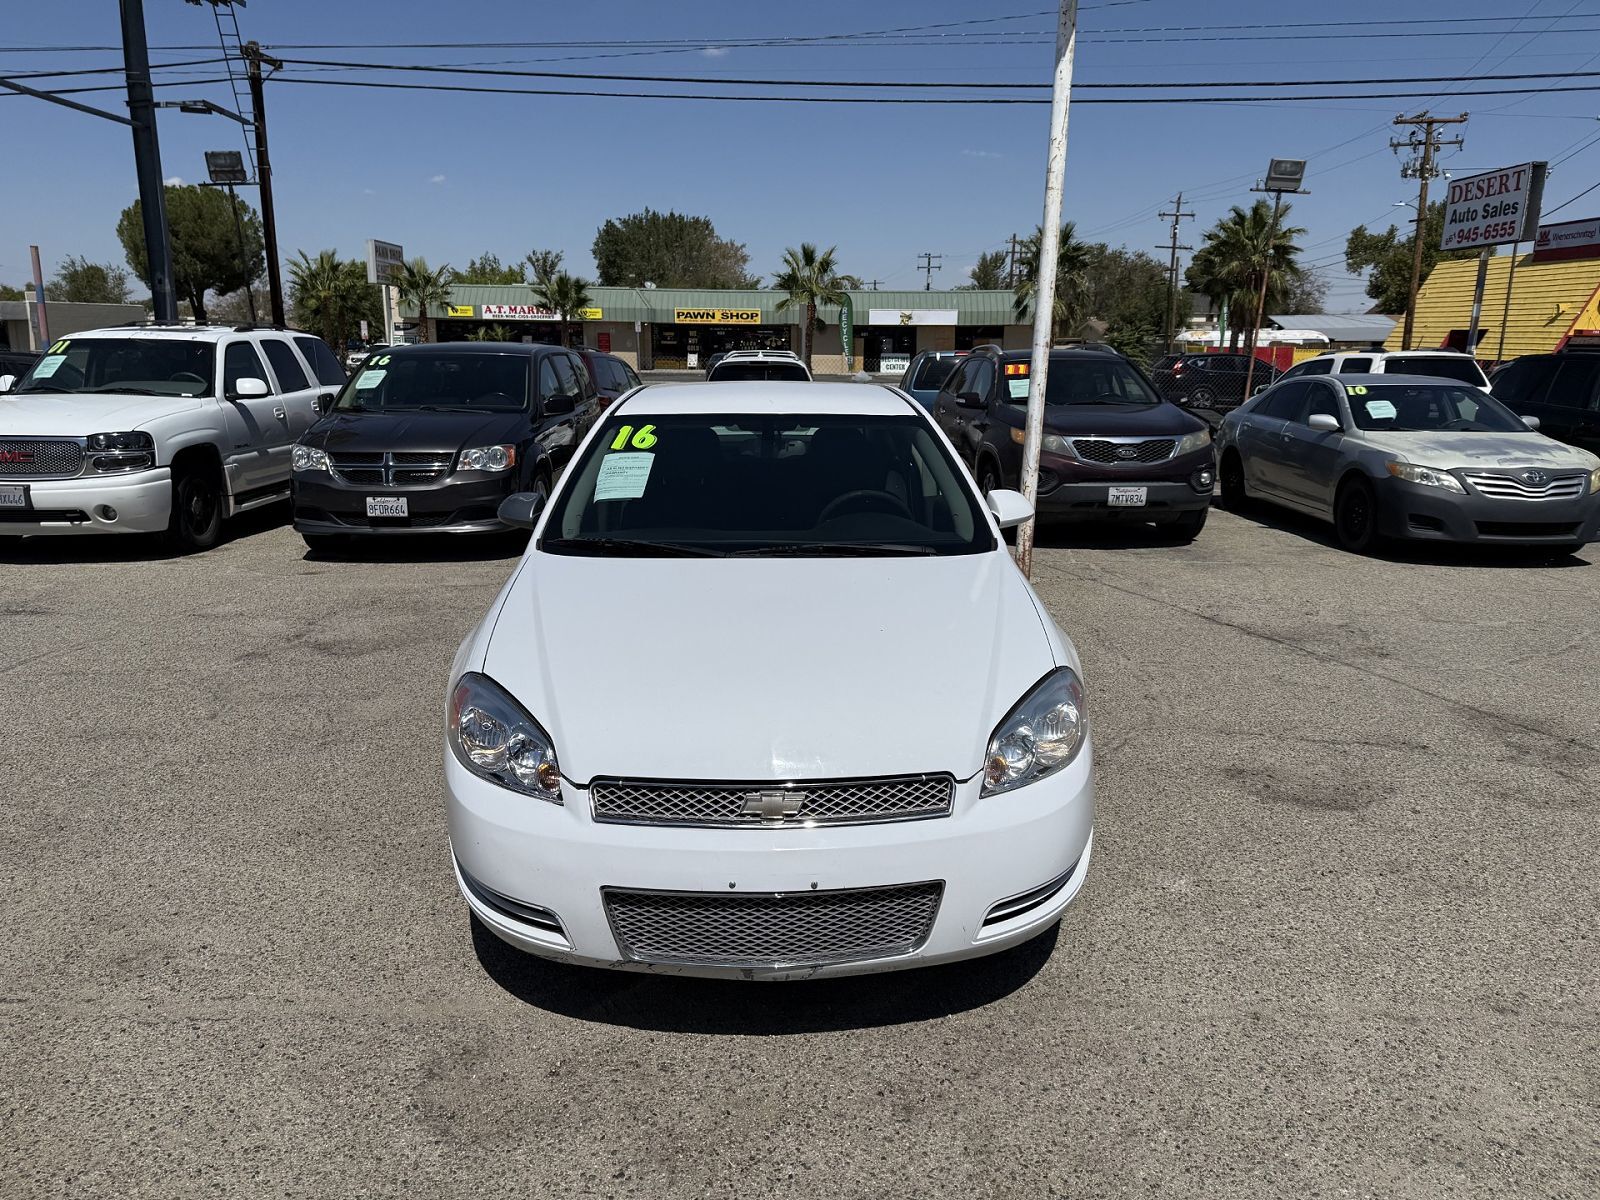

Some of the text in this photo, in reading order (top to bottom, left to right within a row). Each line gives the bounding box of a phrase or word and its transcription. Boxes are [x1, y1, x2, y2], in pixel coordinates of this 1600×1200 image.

[1450, 169, 1526, 204] DESERT
[1450, 201, 1519, 225] Auto Sales
[1457, 220, 1516, 244] 945-6555
[484, 305, 506, 314] A.T.
[676, 311, 759, 320] PAWN SHOP
[369, 355, 392, 366] 16
[1346, 385, 1368, 396] 10
[610, 424, 658, 450] 16
[0, 451, 33, 463] MC
[1110, 494, 1144, 504] 7MTV834
